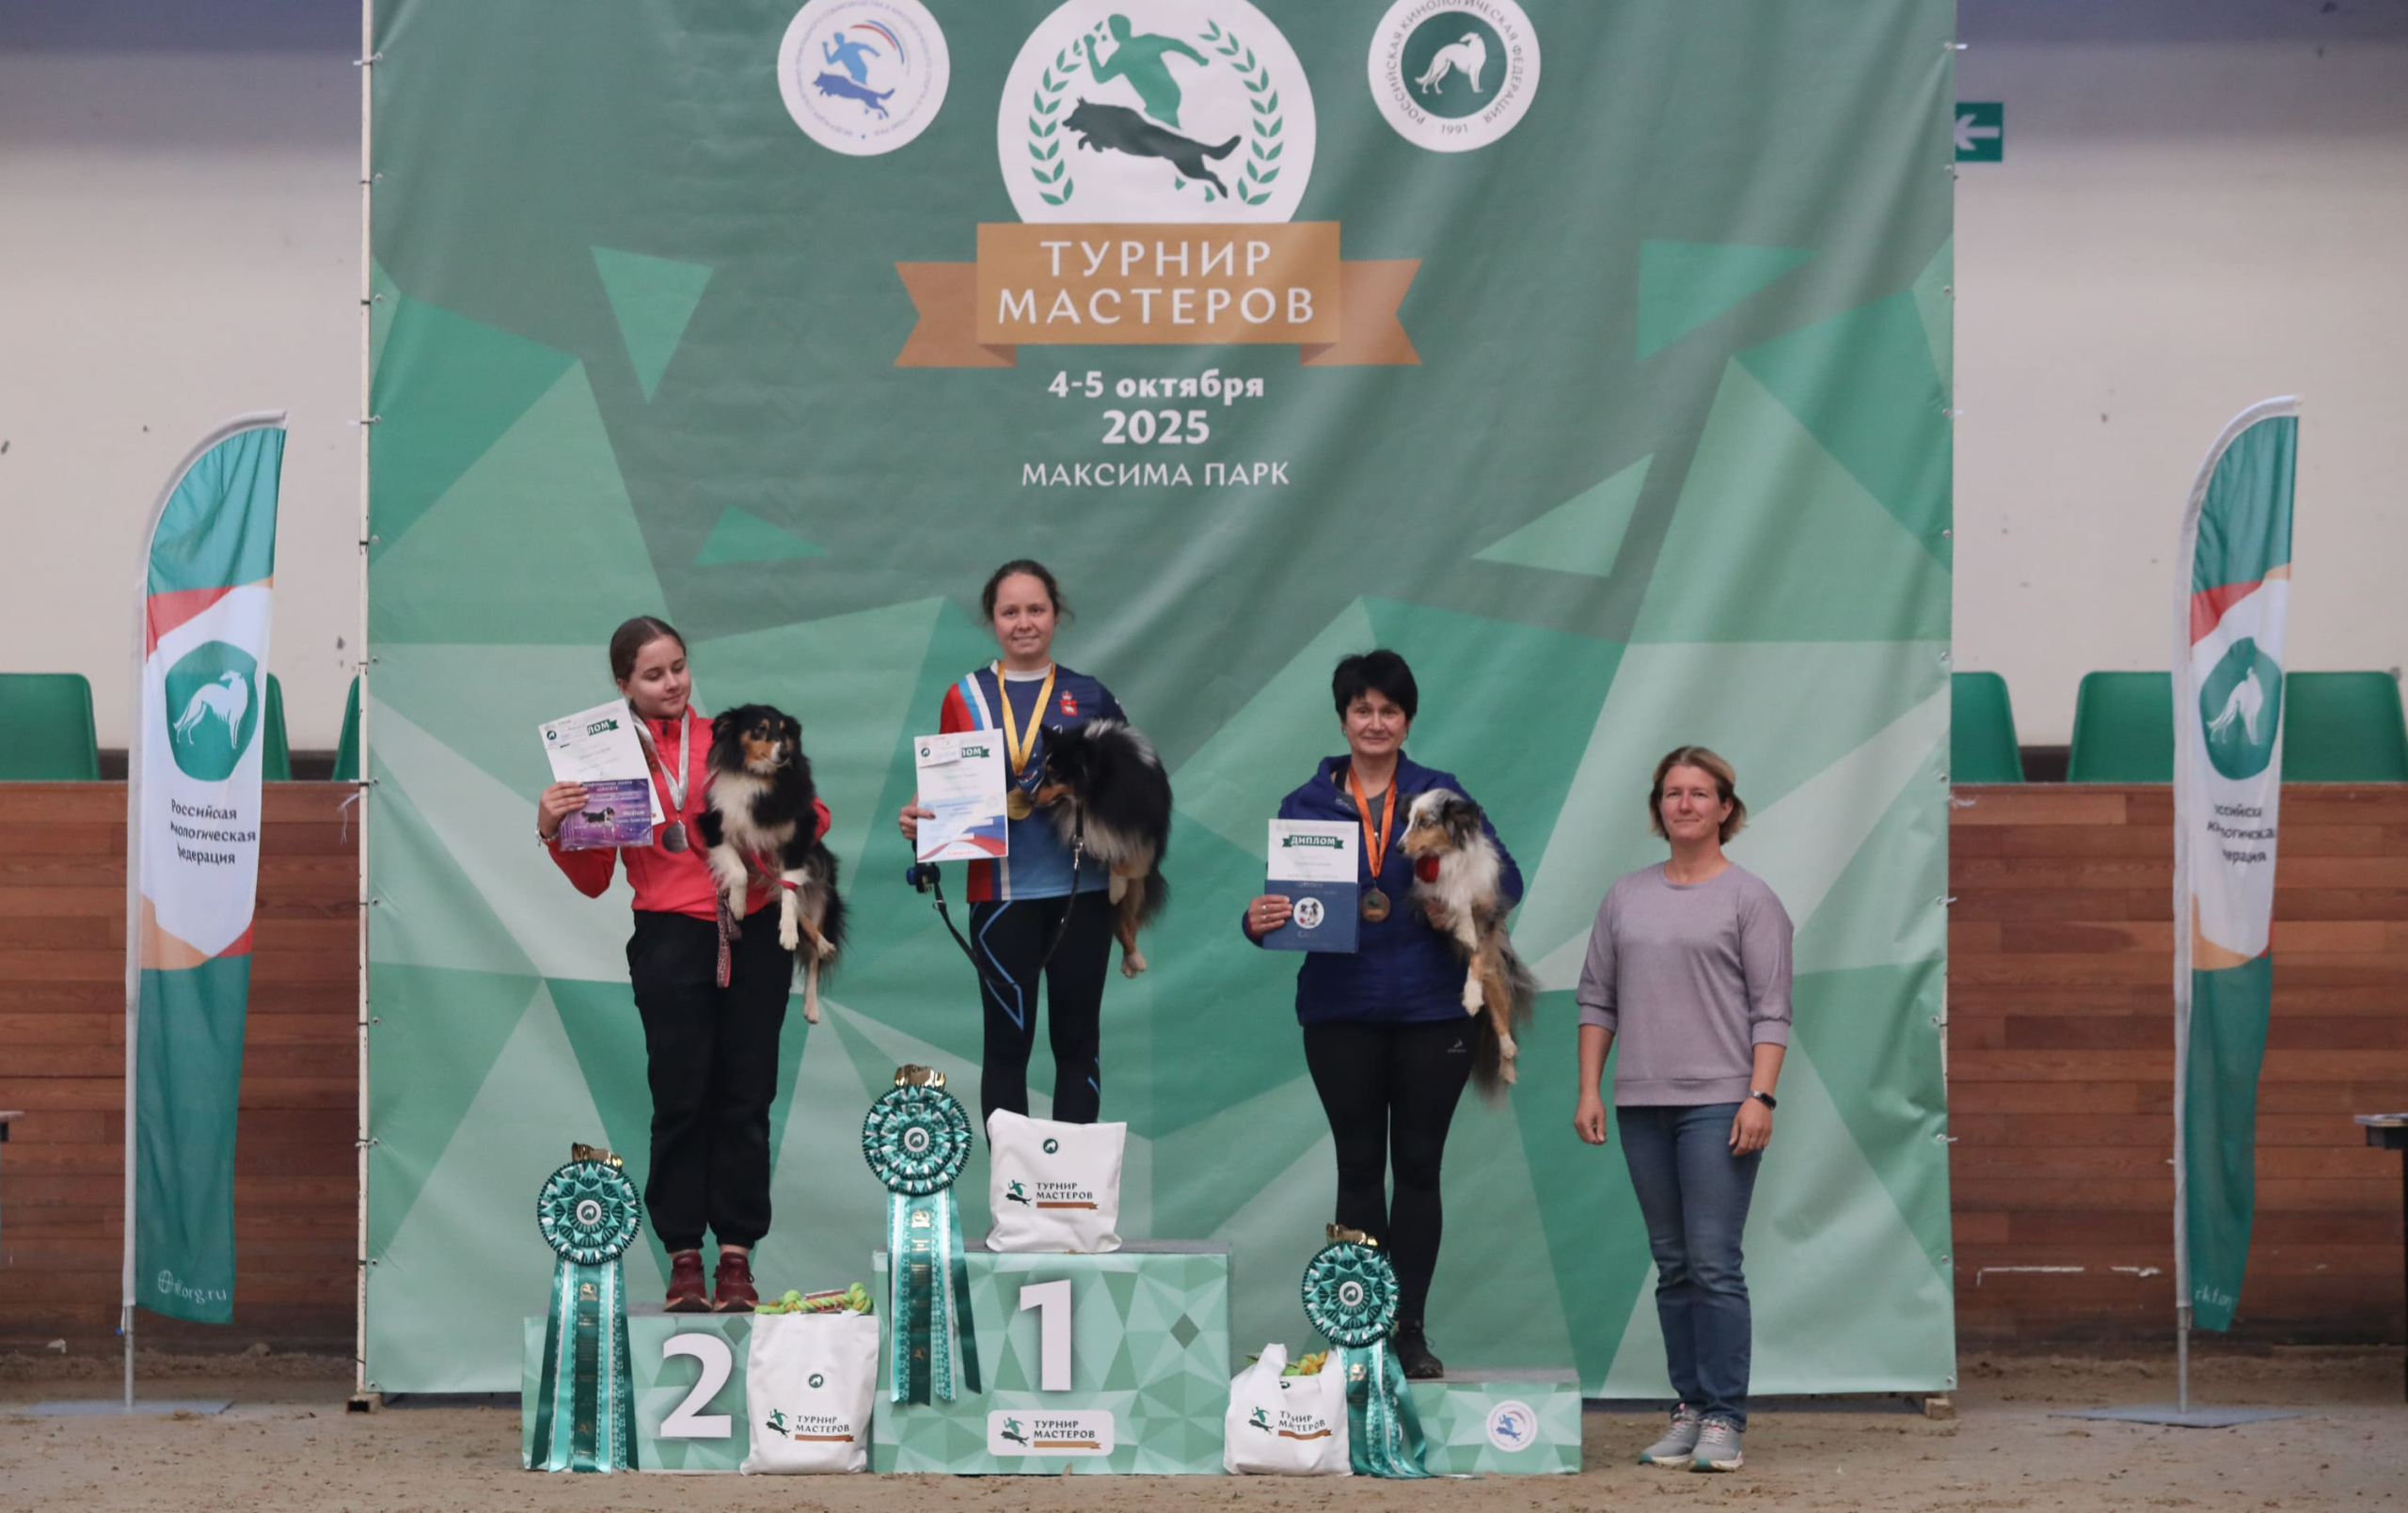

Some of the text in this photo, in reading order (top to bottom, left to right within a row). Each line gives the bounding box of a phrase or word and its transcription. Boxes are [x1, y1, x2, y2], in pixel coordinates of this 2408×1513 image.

[1386, 31, 1426, 125] РОССИЙСКАЯ
[1482, 44, 1525, 124] ФЕДЕРАЦИЯ
[1440, 123, 1468, 134] 1991
[1040, 241, 1271, 276] ТУРНИР
[998, 288, 1314, 323] МАСТЕРОВ
[1048, 369, 1264, 405] 4-5 октября
[1101, 410, 1211, 444] 2025
[1022, 462, 1290, 486] МАКСИМА ПАРК
[1291, 836, 1336, 845] ДИПЛОМ
[1037, 1182, 1078, 1190] ТУРНИР
[1036, 1191, 1093, 1200] МАСТЕРОВ
[1020, 1279, 1071, 1391] 1
[660, 1332, 733, 1439] 2
[796, 1424, 850, 1433] МАСТЕРОВ
[797, 1415, 838, 1425] ТУРНИР
[1034, 1420, 1079, 1428] ТУРНИР
[1034, 1429, 1096, 1439] МАСТЕРОВ
